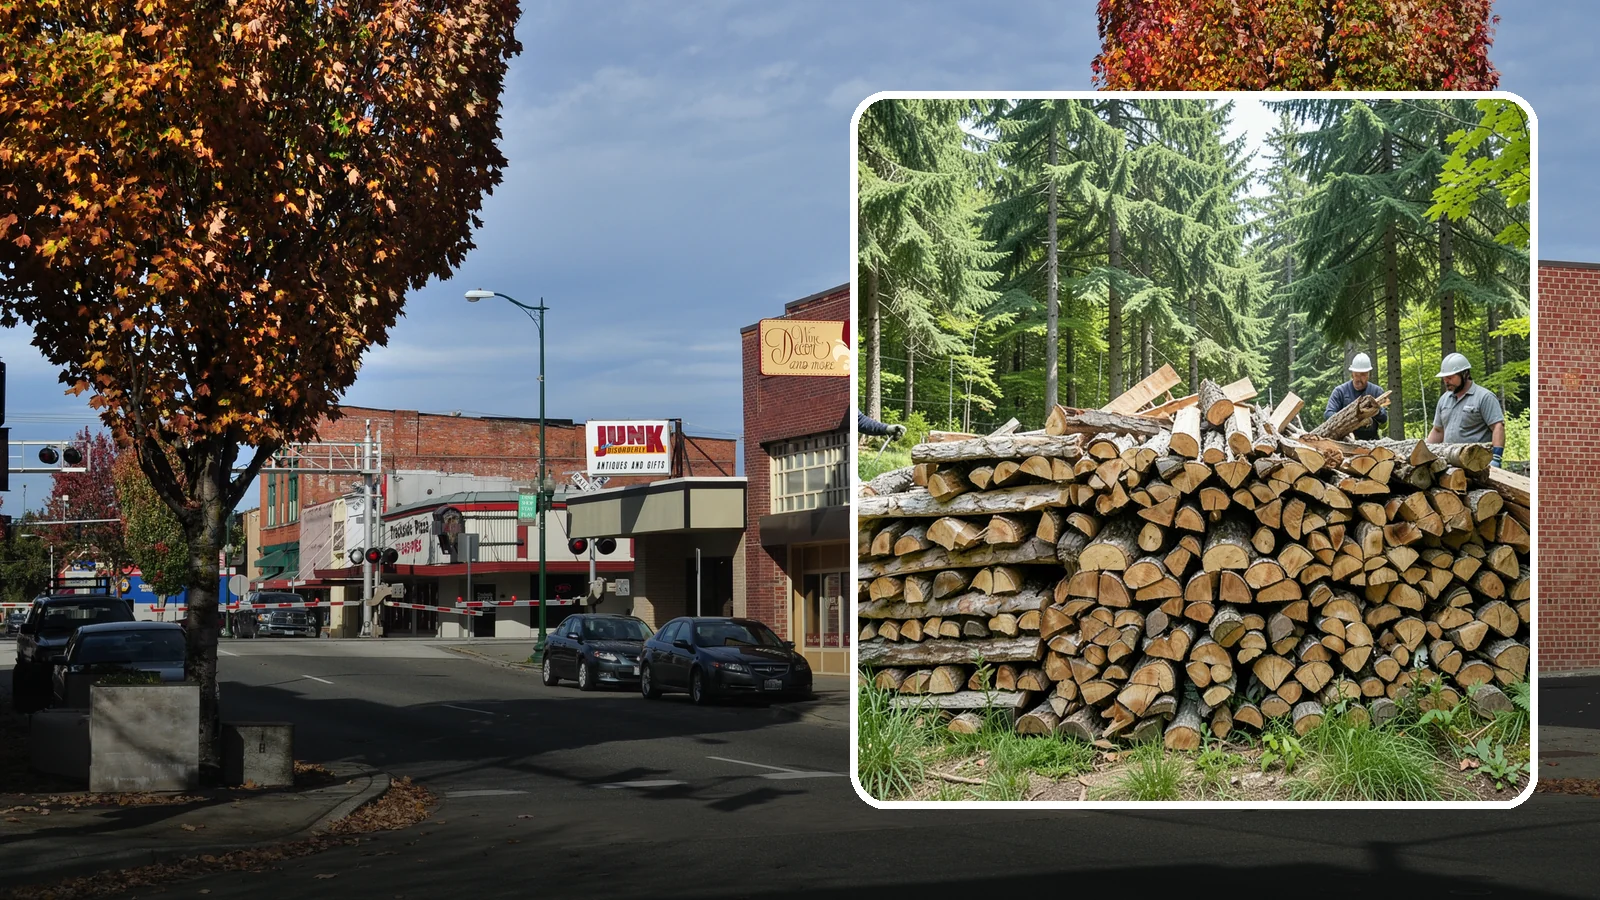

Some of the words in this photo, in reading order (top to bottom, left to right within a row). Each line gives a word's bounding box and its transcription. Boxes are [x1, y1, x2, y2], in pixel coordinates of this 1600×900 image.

[765, 327, 830, 365] Decor
[595, 425, 665, 457] JUNK
[607, 446, 646, 454] DISORDERLY
[597, 461, 628, 470] ANTIQUES
[631, 461, 644, 470] AND
[647, 461, 665, 469] GIFTS
[589, 476, 608, 491] SING
[390, 521, 412, 540] Trackside
[414, 519, 429, 535] Pizza
